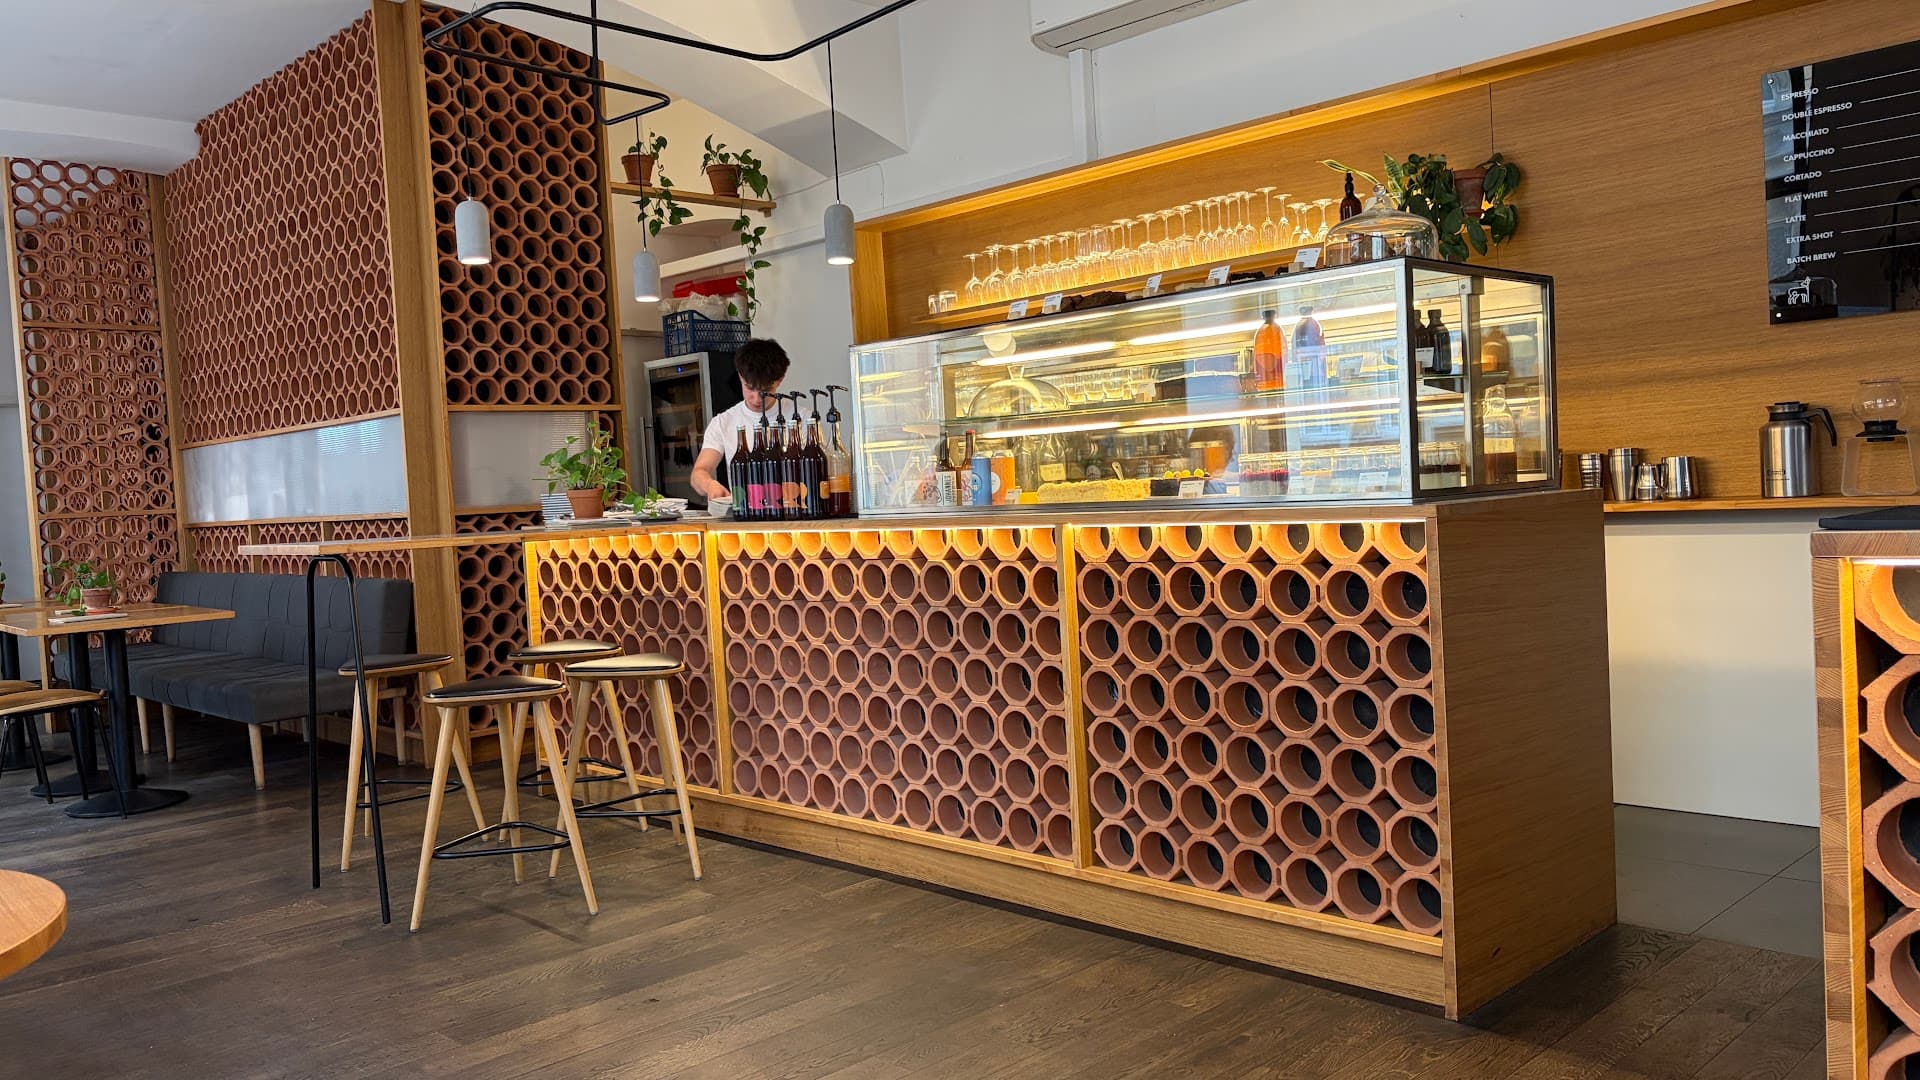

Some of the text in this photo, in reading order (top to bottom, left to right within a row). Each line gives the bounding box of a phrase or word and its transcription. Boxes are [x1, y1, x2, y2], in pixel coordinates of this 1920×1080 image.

[1781, 87, 1819, 100] ESPRESSO
[1782, 102, 1853, 121] DOUBLE ESPRESSO
[1783, 127, 1830, 142] MACCHIATO
[1783, 147, 1836, 162] CAPPUCCINO
[1784, 170, 1822, 183] CORTADO
[1784, 190, 1829, 203] FLAT WHITE
[1785, 214, 1807, 224] LATTE
[1786, 231, 1834, 244] EXTRA SHOT
[1787, 251, 1837, 265] BATCH BREW
